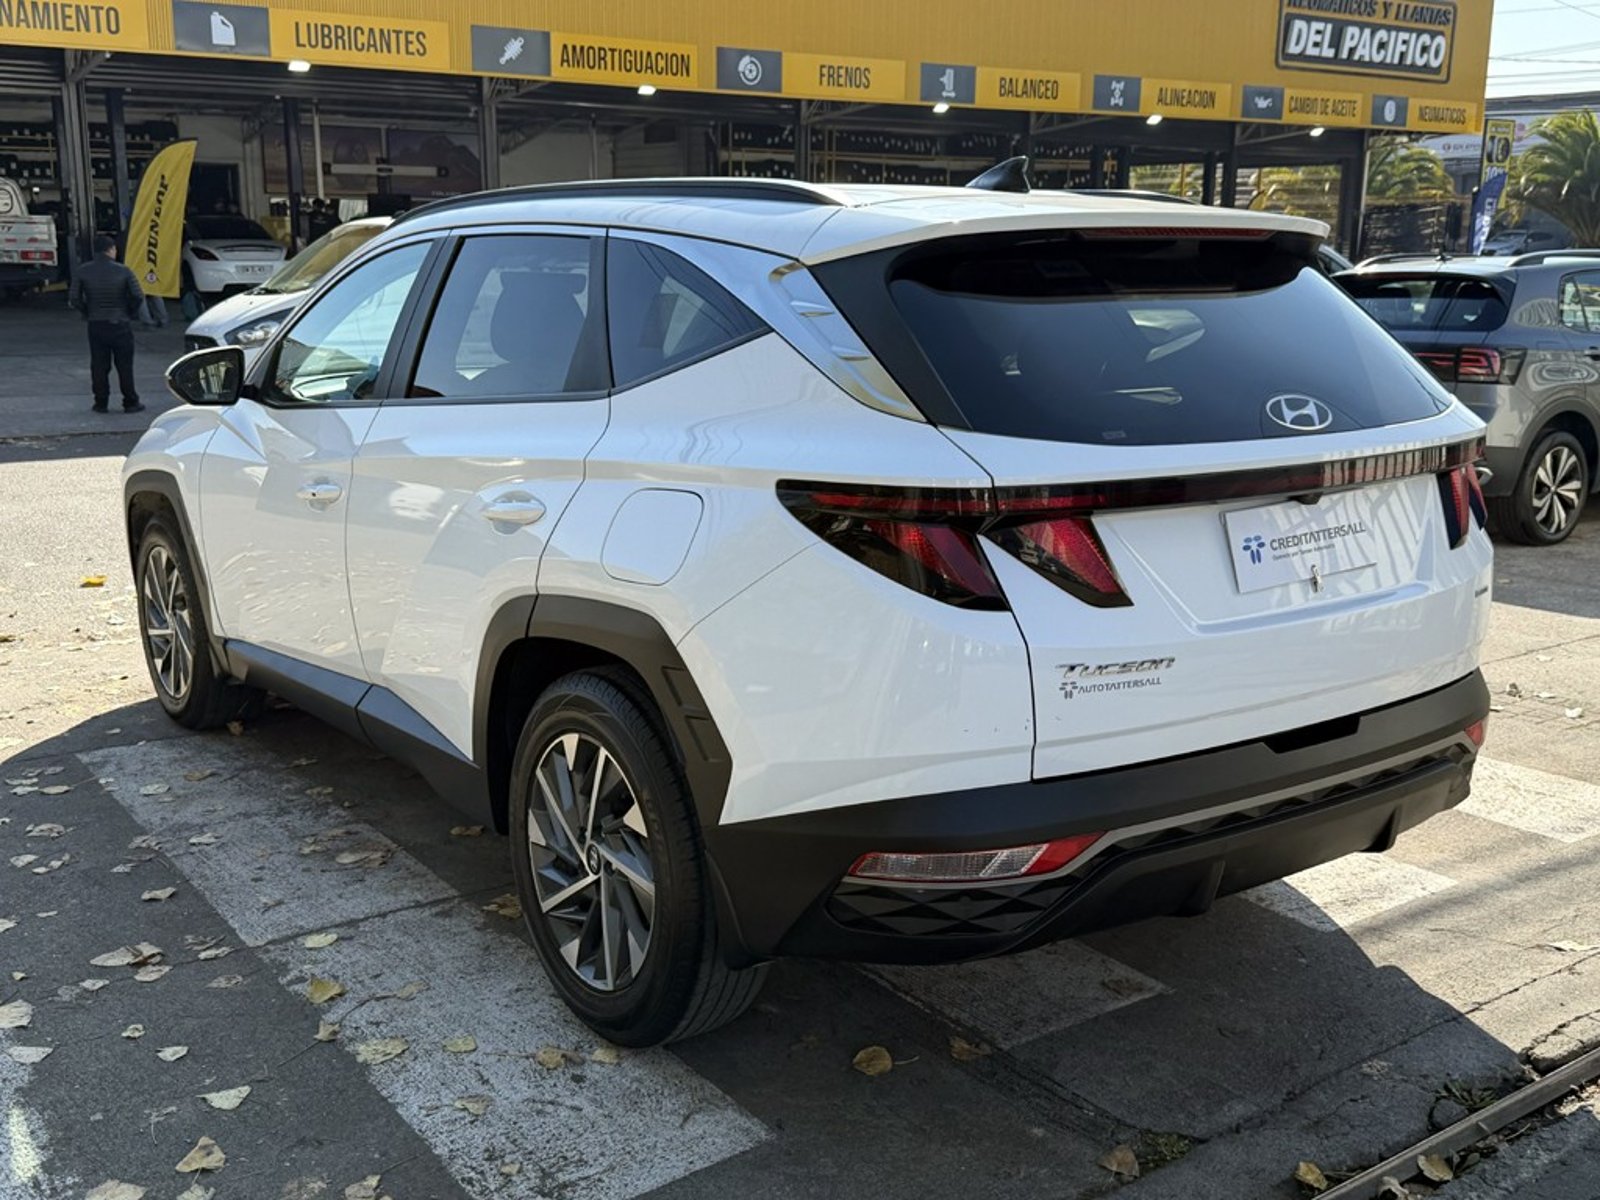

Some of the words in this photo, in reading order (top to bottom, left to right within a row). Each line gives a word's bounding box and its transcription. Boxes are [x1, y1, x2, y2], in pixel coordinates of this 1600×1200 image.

[0, 0, 120, 35] NAMIENTO
[1382, 1, 1394, 19] Y
[1395, 3, 1451, 26] LLANTAS
[294, 21, 427, 57] LUBRICANTES
[1285, 19, 1336, 59] DEL
[1338, 26, 1446, 69] PACIFICO
[560, 43, 691, 78] AMORTIGUACION
[818, 64, 871, 89] FRENOS
[999, 76, 1059, 100] BALANCEO
[1157, 87, 1217, 109] ALINEACION
[1288, 95, 1318, 115] CAMBIO
[1319, 98, 1330, 116] DE
[1331, 99, 1358, 118] ACEITE
[1418, 105, 1467, 125] NEUMATICOS
[147, 174, 169, 268] DUNLOP
[1269, 522, 1366, 551] CREDITATTERSALL
[1078, 677, 1162, 694] AUTOTATTERSALL
